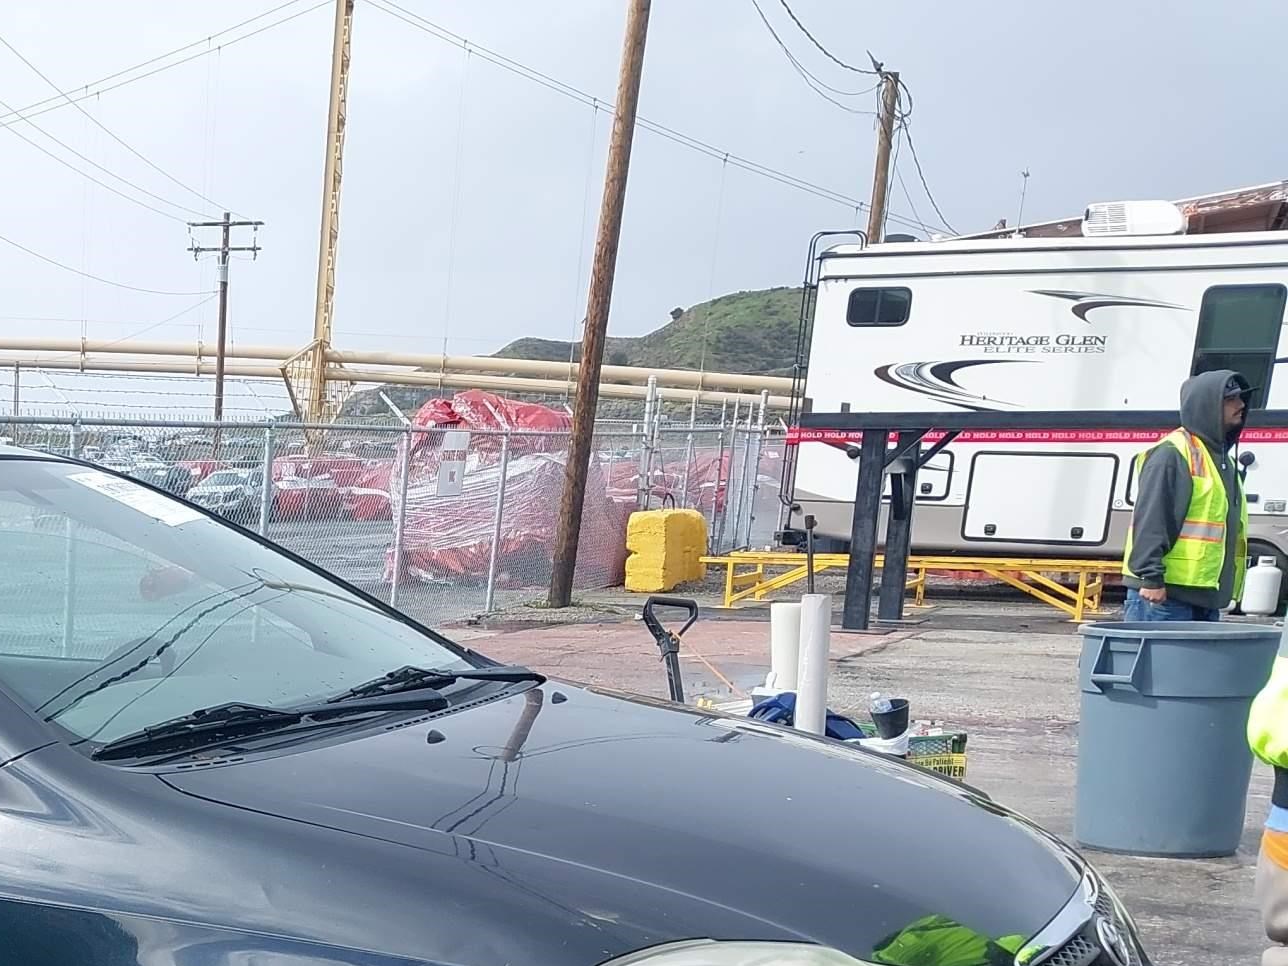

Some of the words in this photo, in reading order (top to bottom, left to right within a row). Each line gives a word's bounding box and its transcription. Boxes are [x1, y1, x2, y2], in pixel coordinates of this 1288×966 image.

[959, 334, 1050, 346] HERITAGE
[1055, 334, 1108, 346] GLEN
[983, 346, 1037, 354] ELITE
[1040, 346, 1106, 354] SERIES
[801, 431, 823, 439] HOLD
[824, 431, 847, 439] HOLD
[972, 432, 997, 440] HOLD
[998, 432, 1023, 440] HOLD
[1025, 432, 1049, 440] HOLD
[1051, 432, 1076, 440] HOLD
[1078, 432, 1103, 440] HOLD
[1105, 432, 1130, 440] HOLD
[1132, 432, 1158, 440] HOLD
[1244, 432, 1272, 440] HOLD
